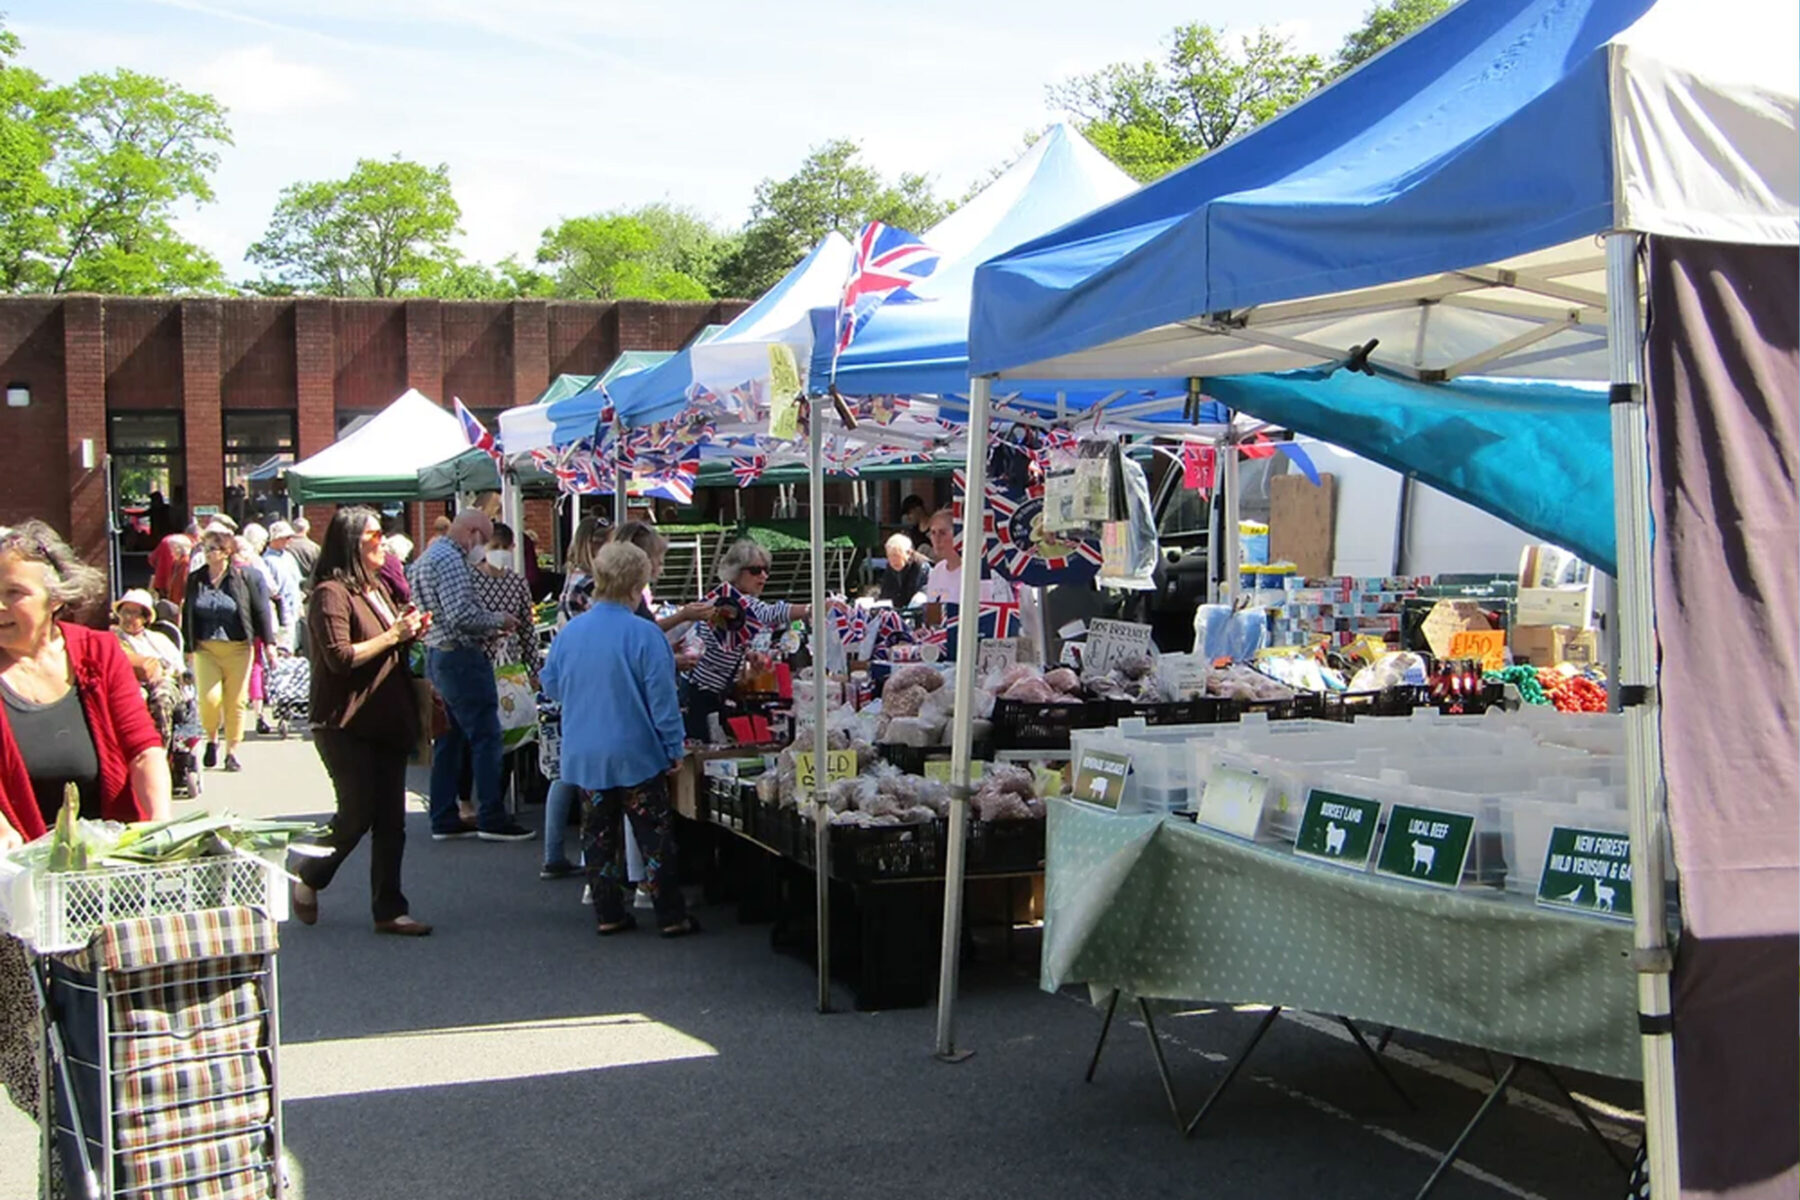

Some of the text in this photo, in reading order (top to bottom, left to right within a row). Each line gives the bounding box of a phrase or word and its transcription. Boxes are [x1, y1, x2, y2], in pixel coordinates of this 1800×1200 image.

[1451, 631, 1492, 657] £1.50
[803, 754, 850, 773] WLD
[1320, 801, 1363, 824] DORSET LAMB
[1408, 818, 1450, 839] LOCAL BEEF
[1574, 834, 1630, 858] NEW FOREST
[1550, 853, 1633, 881] WILD VENISON & GA
